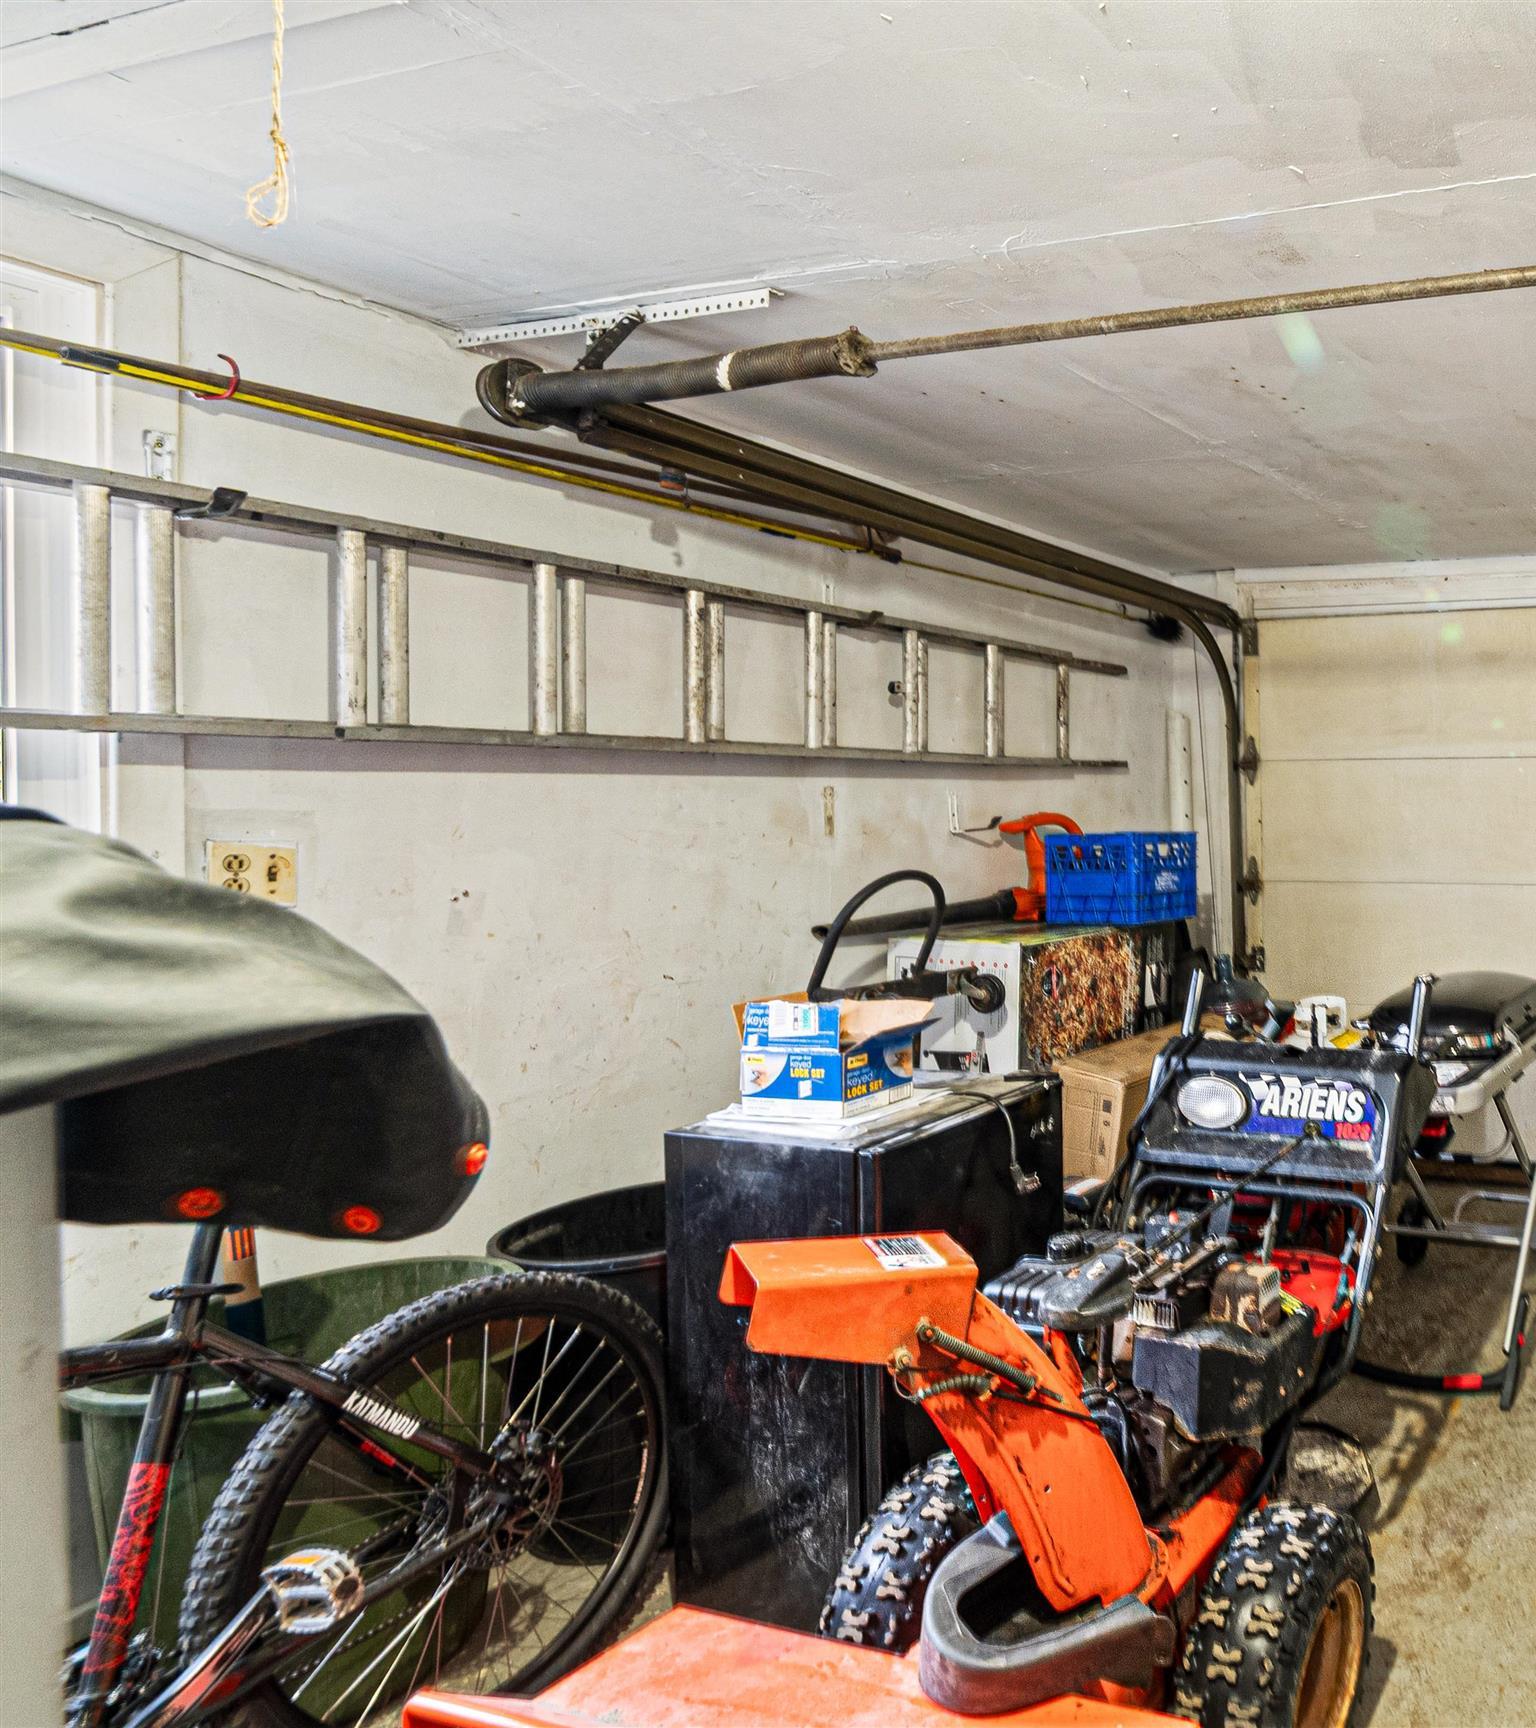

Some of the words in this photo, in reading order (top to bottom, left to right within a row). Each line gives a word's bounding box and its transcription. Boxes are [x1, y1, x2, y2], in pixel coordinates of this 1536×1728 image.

[747, 1013, 769, 1028] keye
[790, 1067, 809, 1078] LOCK
[811, 1068, 825, 1079] SET
[847, 1083, 868, 1099] LOCK
[869, 1077, 884, 1092] SET
[1260, 1082, 1367, 1123] ARIENS
[342, 1390, 420, 1439] KATMANDU
